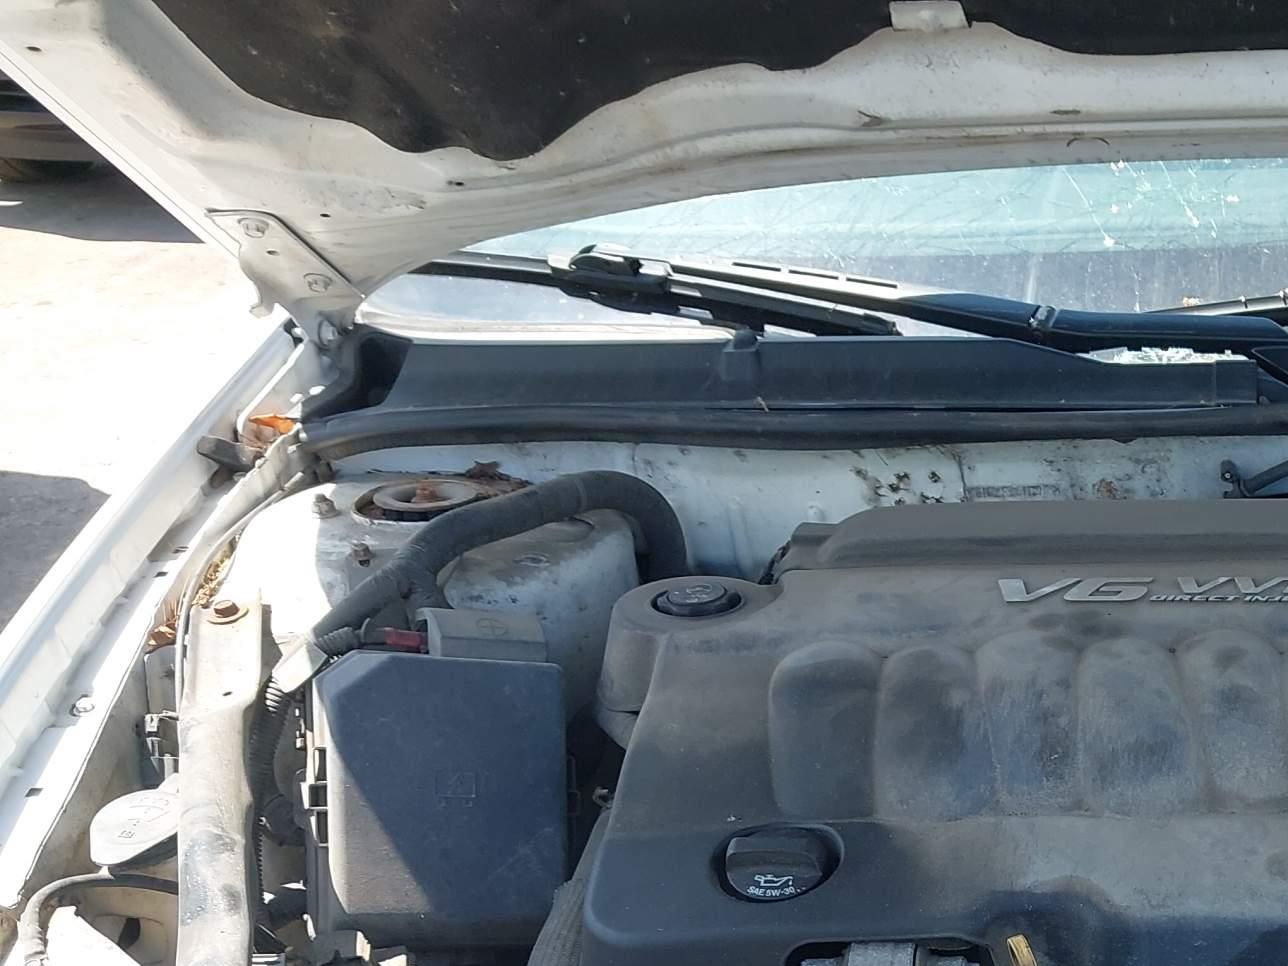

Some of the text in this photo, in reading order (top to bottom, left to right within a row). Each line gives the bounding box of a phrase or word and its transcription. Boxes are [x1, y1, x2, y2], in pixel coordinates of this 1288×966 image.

[999, 577, 1154, 602] V6
[1150, 594, 1240, 602] DIRECT
[747, 886, 796, 897] SAE 5W-30
